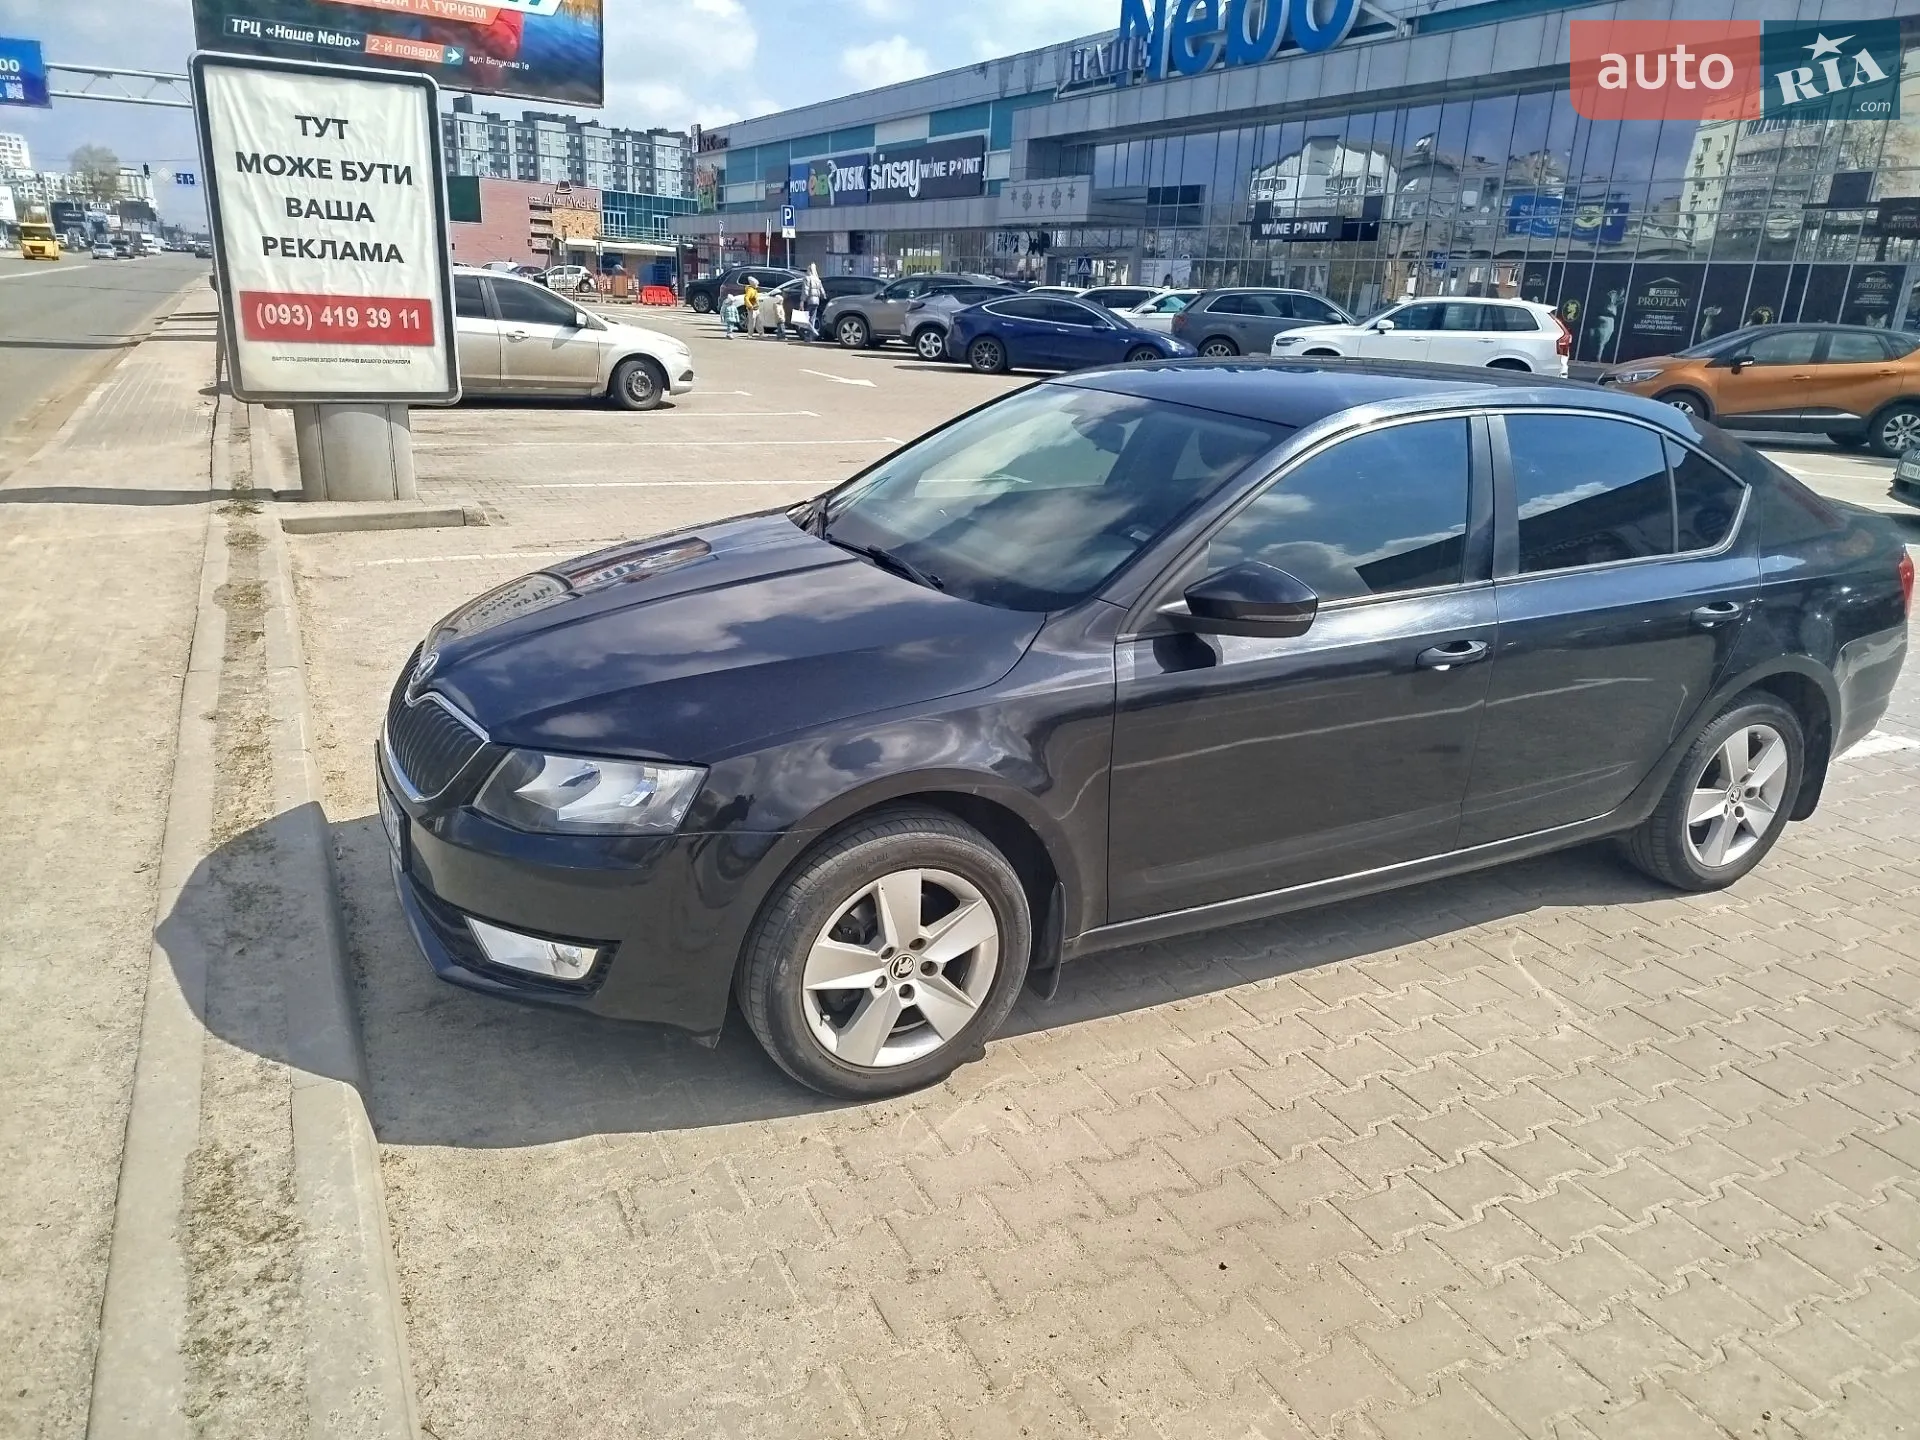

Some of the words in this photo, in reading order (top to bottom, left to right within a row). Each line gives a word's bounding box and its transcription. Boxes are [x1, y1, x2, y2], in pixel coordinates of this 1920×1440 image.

[434, 1, 487, 19] ТУРИЗМ
[231, 18, 261, 37] ТРЦ
[371, 38, 393, 53] 2-й
[396, 44, 440, 60] поверх
[294, 114, 349, 140] ТУТ
[235, 151, 333, 180] МОЖЕ
[340, 160, 413, 186] БУТИ
[834, 165, 866, 192] JYSK
[871, 153, 920, 198] sinsay
[285, 196, 376, 223] ВАША
[1261, 220, 1291, 236] WINE
[1293, 220, 1330, 236] POINT
[261, 235, 405, 264] РЕКЛАМА
[1636, 296, 1659, 306] PRO
[1659, 297, 1689, 308] PLAN
[256, 302, 313, 331] (093)
[320, 305, 359, 328] 419
[366, 307, 391, 329] 39
[399, 308, 420, 330] 11
